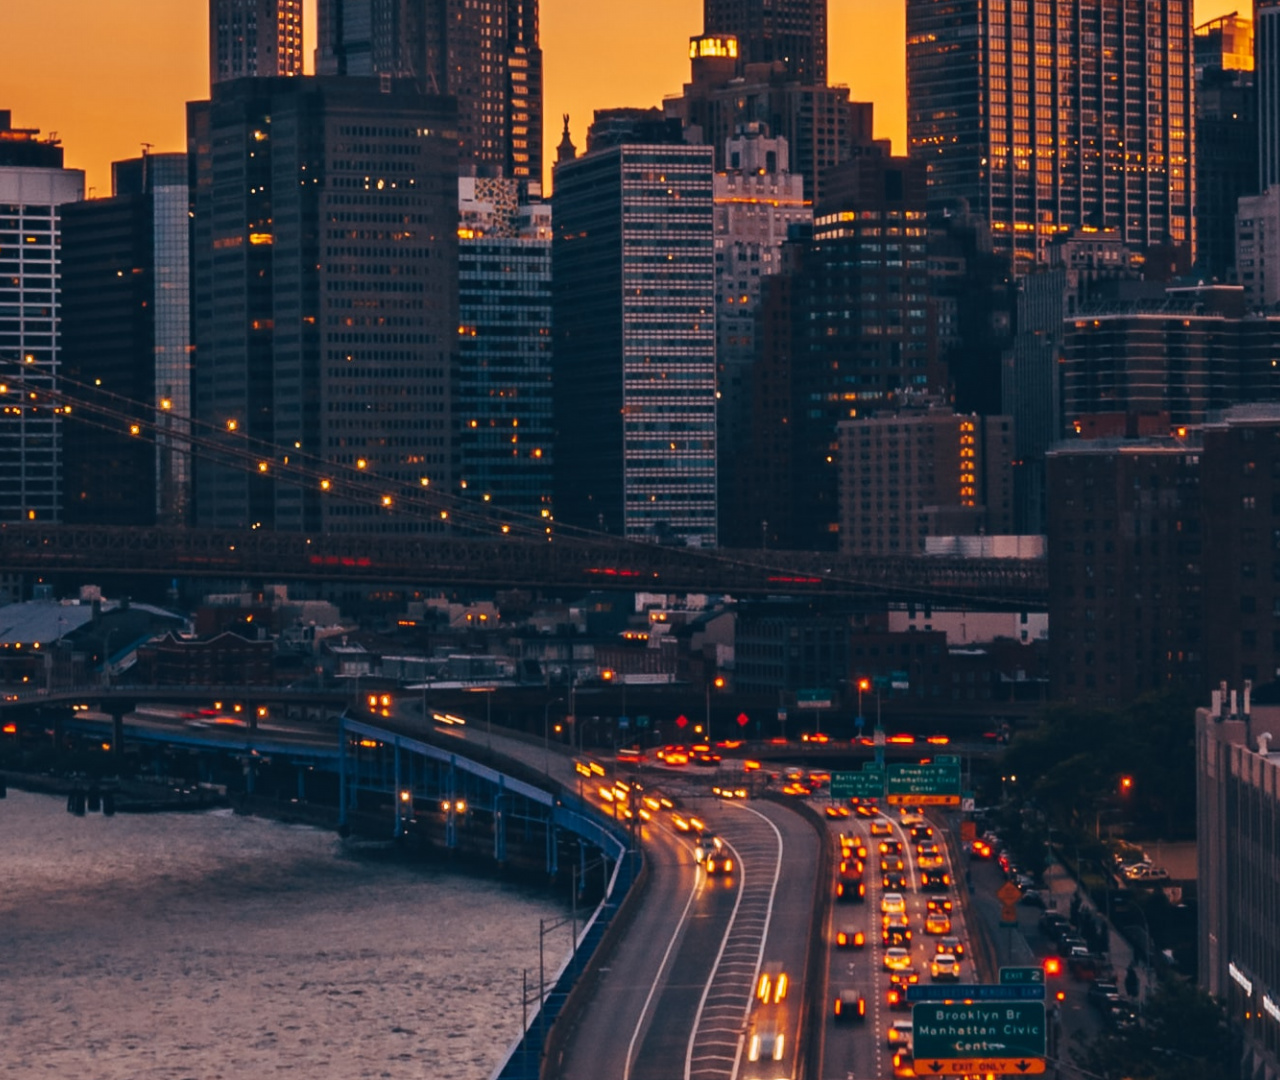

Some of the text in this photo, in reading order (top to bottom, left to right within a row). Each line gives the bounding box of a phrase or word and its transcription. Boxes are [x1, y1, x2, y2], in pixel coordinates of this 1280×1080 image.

[900, 769, 935, 777] Brooklyn
[1005, 970, 1040, 981] EXIT 2
[936, 1010, 1021, 1022] Brooklyn Br
[919, 1025, 1039, 1036] Manhattan Civic
[952, 1063, 1006, 1071] EXIT ONLY
